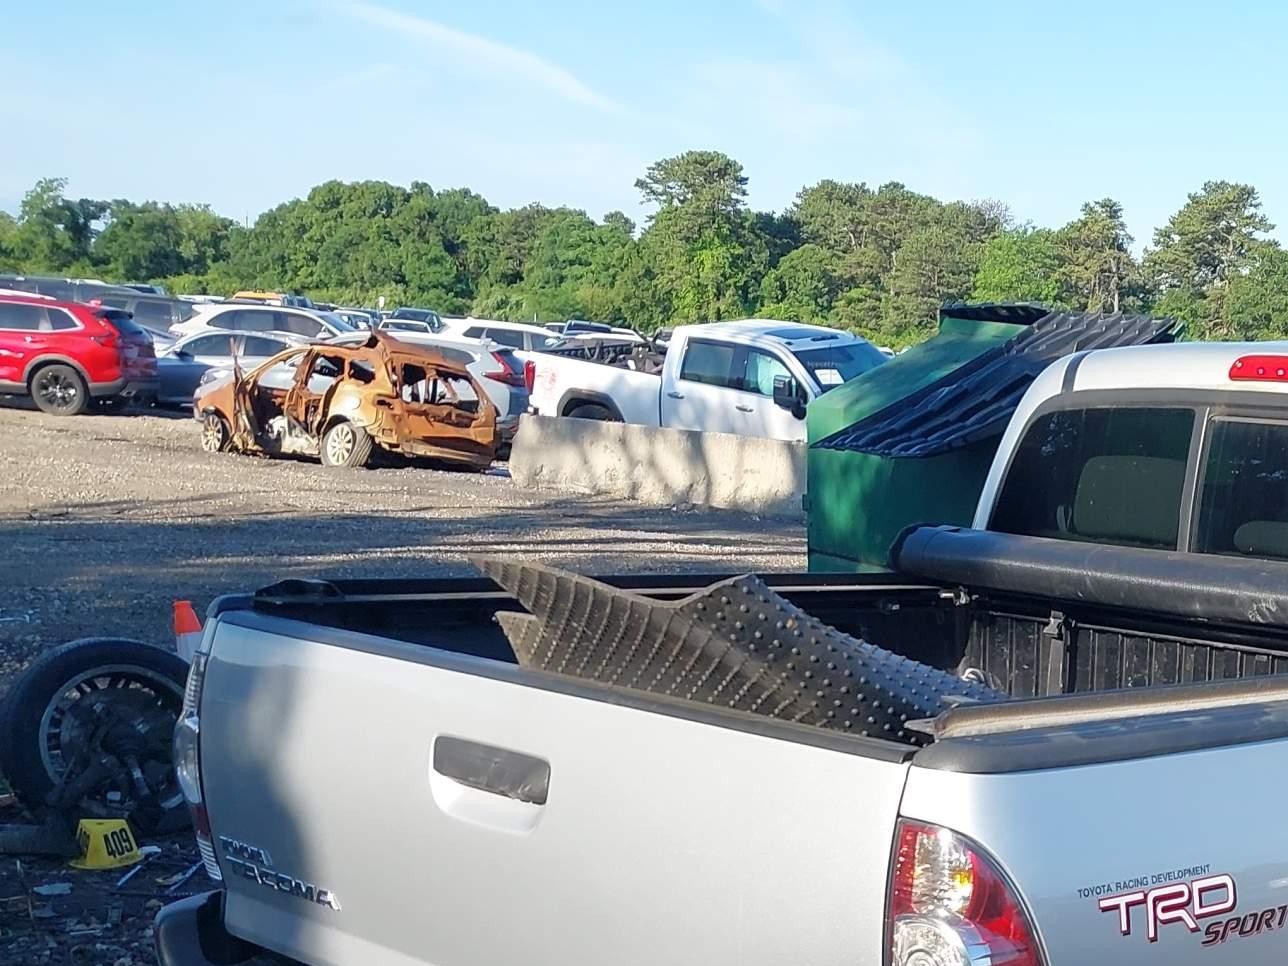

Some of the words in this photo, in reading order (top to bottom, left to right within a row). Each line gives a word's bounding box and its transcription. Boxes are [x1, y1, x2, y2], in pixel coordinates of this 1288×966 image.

[103, 827, 134, 858] 409
[1077, 884, 1113, 899] TOYOTA
[1115, 876, 1149, 892] RACING
[1151, 864, 1211, 885] DEVELOPMENT
[1098, 873, 1238, 943] TRD
